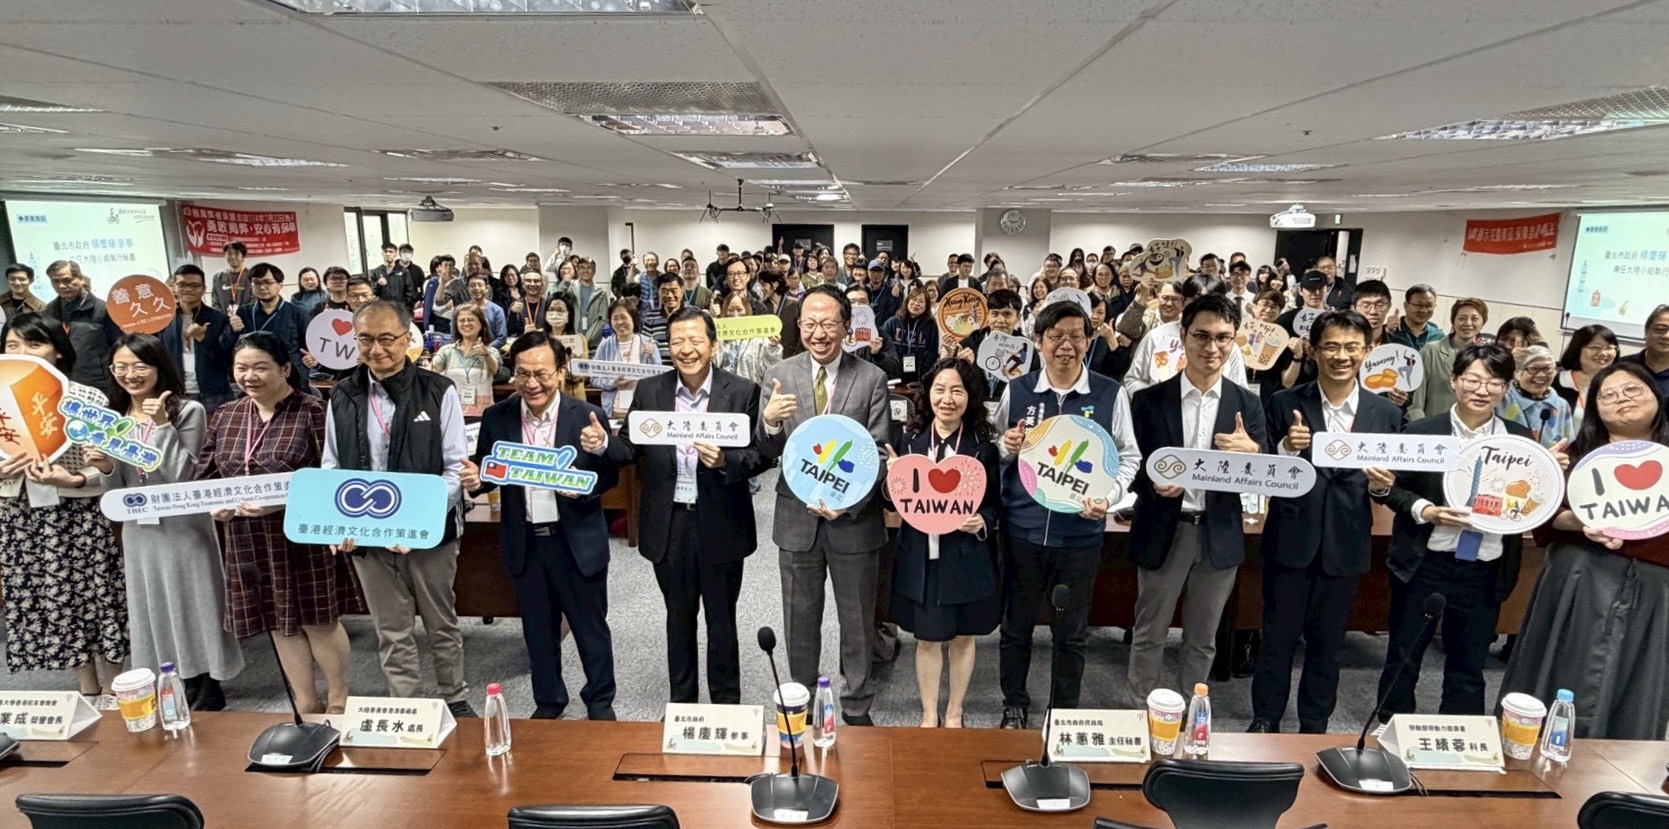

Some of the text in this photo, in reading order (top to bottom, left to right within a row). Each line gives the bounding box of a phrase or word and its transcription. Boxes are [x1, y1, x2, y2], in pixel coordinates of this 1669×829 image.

[667, 420, 739, 432] 大陸委員會
[497, 446, 556, 465] TEAM
[1358, 441, 1448, 455] 大陸委員會
[1416, 456, 1445, 464] Council
[1481, 445, 1533, 471] Taipei
[509, 466, 592, 488] TAIWAN
[801, 458, 850, 494] TAIPEI
[1193, 458, 1304, 479] 大陸委員會
[912, 467, 920, 494] I
[1037, 461, 1090, 495] TAIPEI
[1192, 473, 1299, 490] Mainland Affairs Council
[1591, 467, 1605, 496] I
[127, 506, 148, 515] THEC
[900, 498, 974, 515] TAIWAN
[298, 523, 430, 540] 臺港經濟文化合作策進會
[674, 715, 704, 723] 臺北市政府
[1054, 718, 1103, 726] 臺北市政府民政局
[683, 726, 728, 741] 楊慶輝
